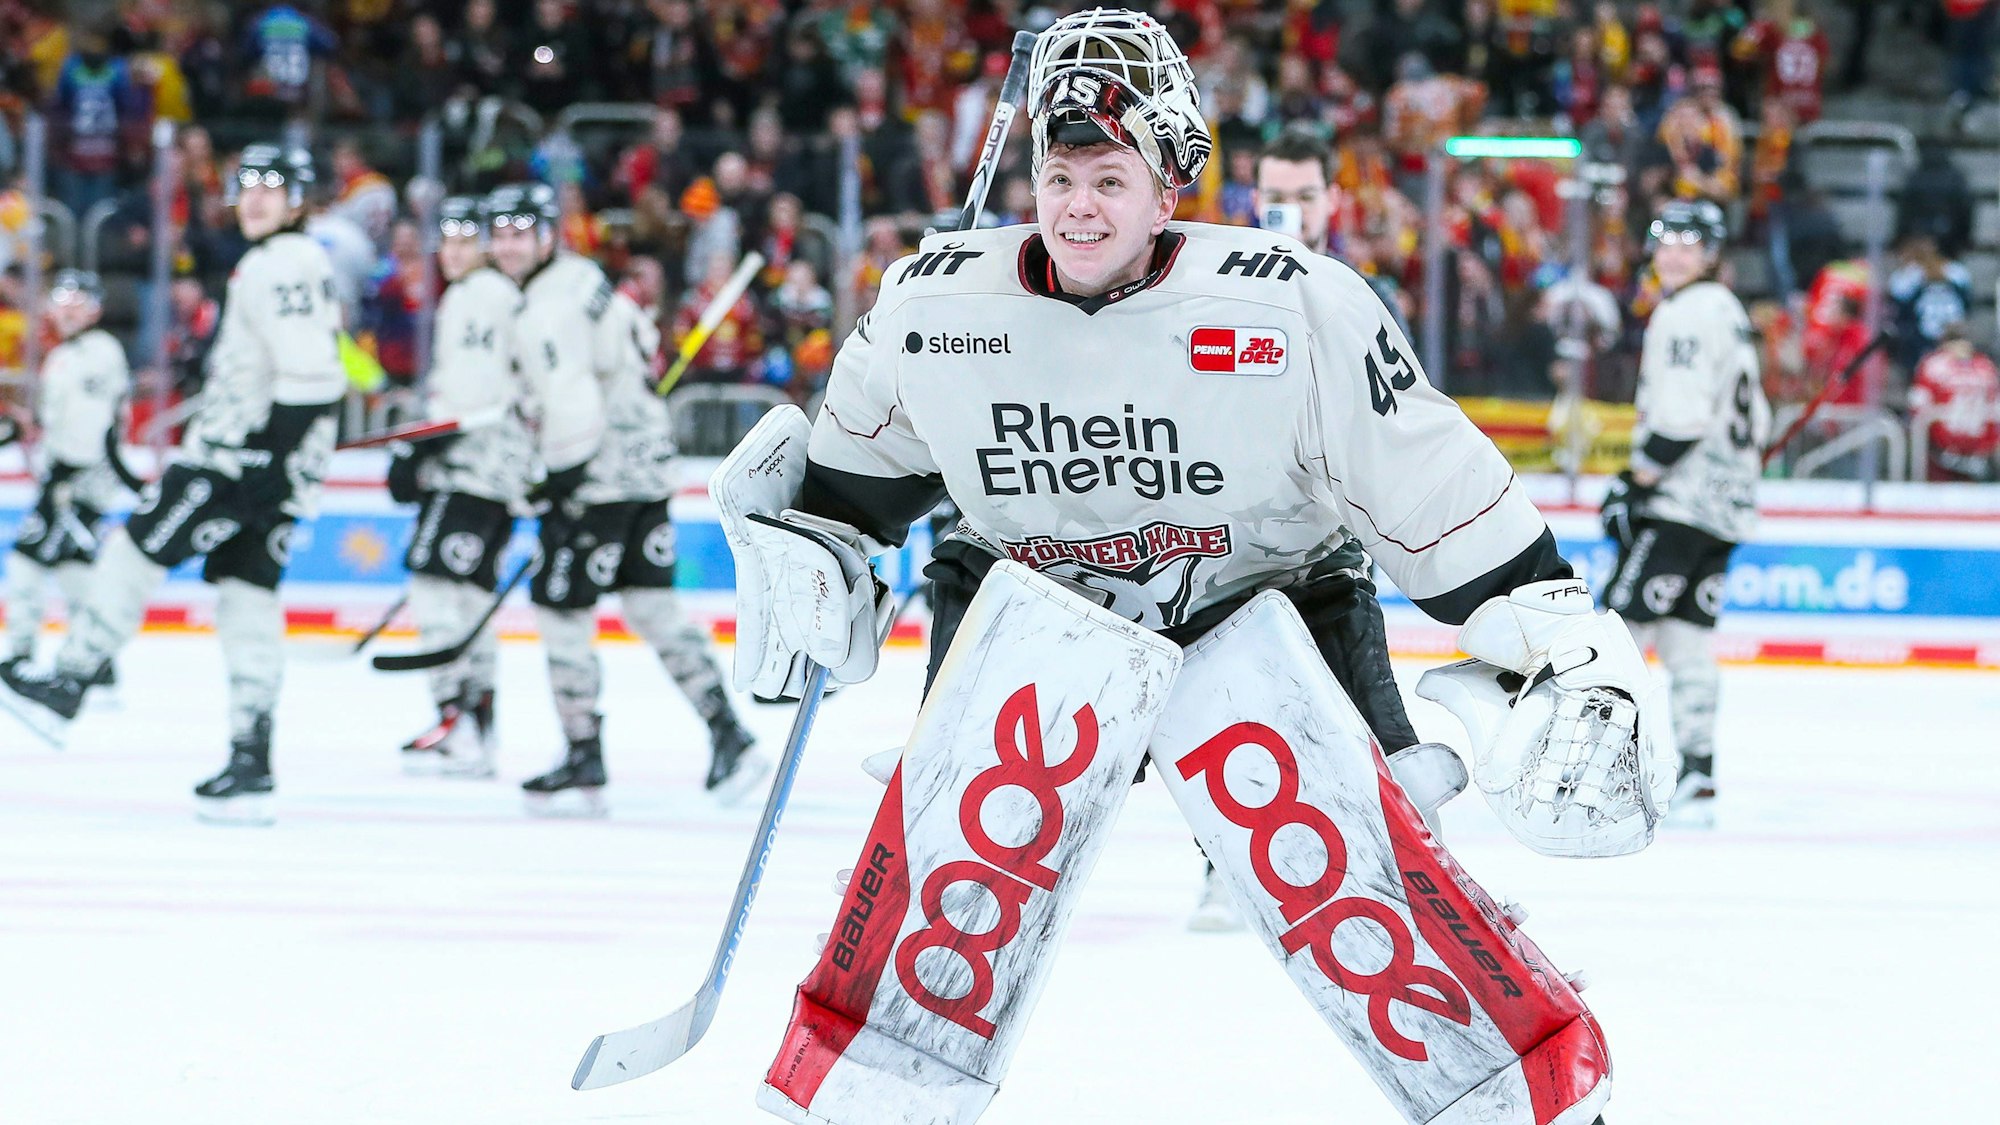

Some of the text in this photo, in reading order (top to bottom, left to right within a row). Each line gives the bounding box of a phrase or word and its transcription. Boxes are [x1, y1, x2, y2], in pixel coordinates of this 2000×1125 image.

[929, 333, 1011, 354] steinel
[1239, 348, 1284, 364] DEL
[1364, 320, 1417, 417] 45
[991, 402, 1179, 454] Rhein
[976, 448, 1225, 501] Energie
[1004, 524, 1228, 571] KÖLNER HAIE
[895, 682, 1099, 1041] pape
[1175, 721, 1472, 1062] pape
